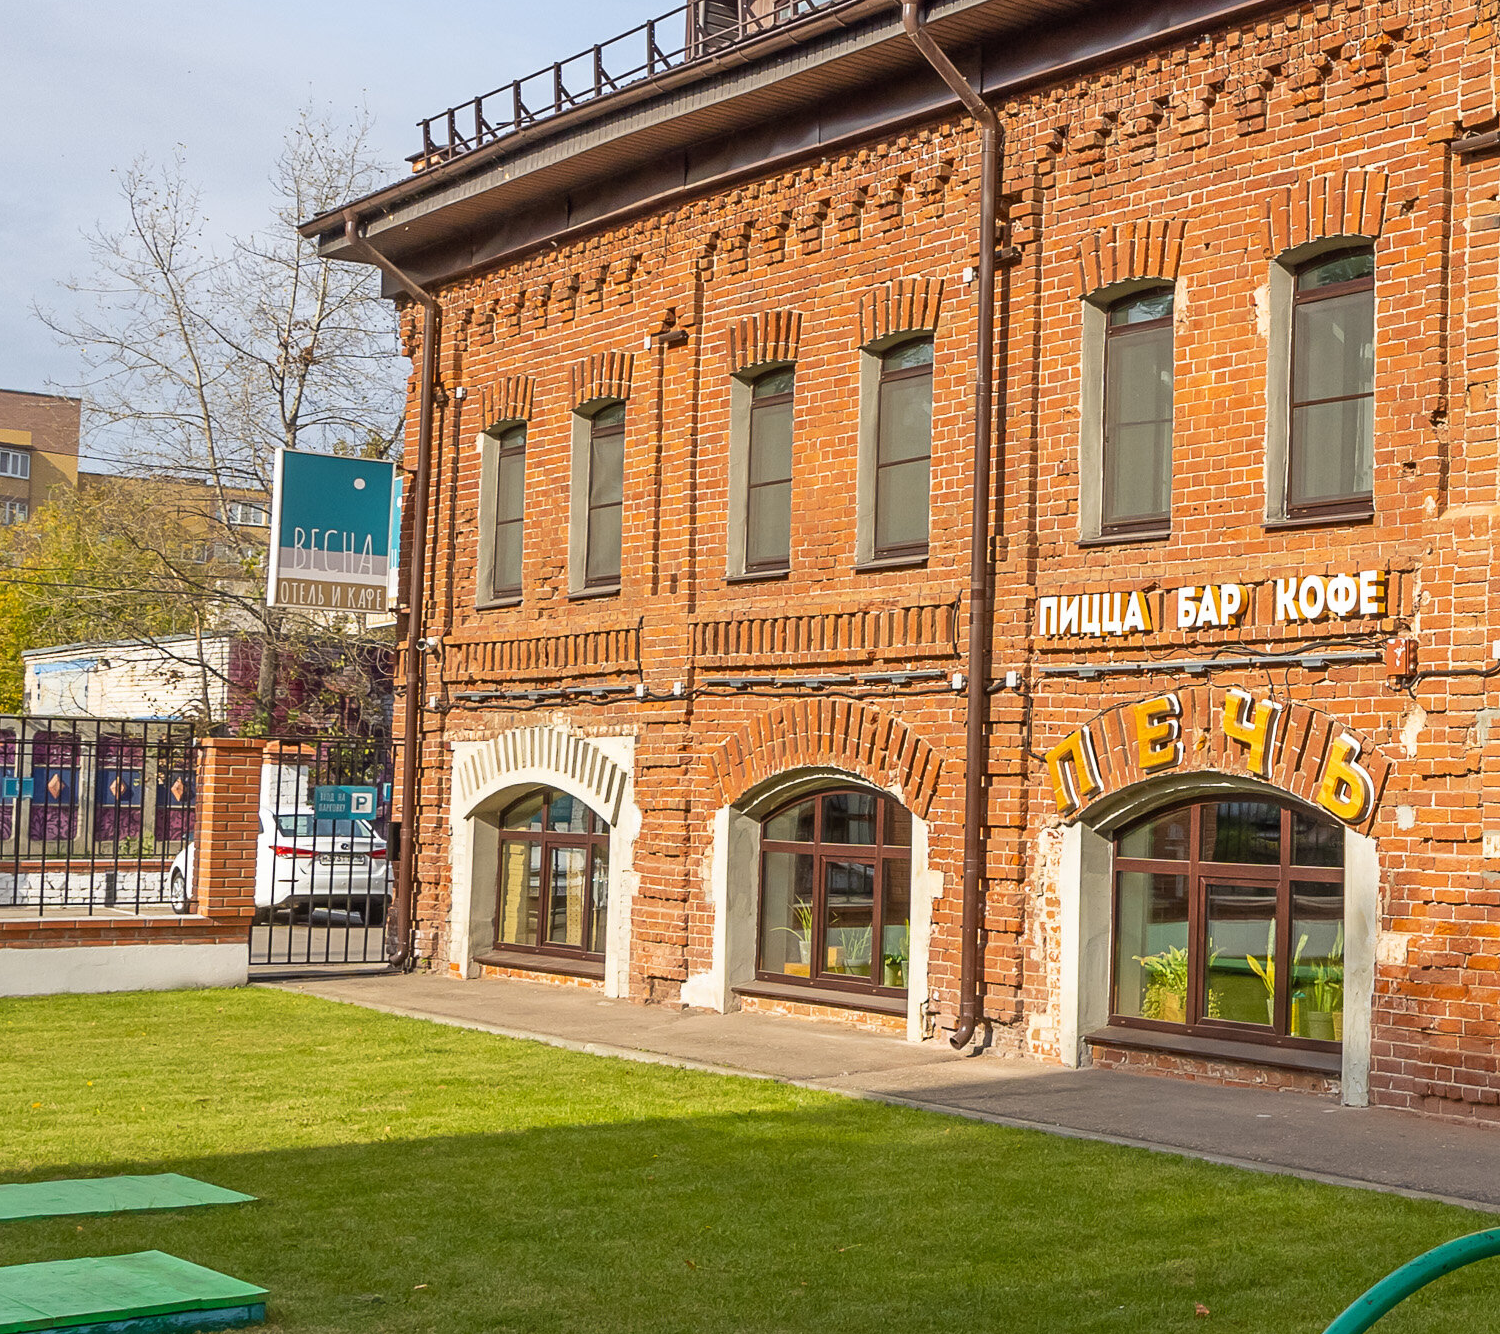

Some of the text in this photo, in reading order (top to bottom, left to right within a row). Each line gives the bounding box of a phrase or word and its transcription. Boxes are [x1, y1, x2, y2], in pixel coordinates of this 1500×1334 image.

[293, 527, 374, 575] ВЕСНА
[280, 581, 382, 610] ОТЕЛЬ И КАФЕ
[1038, 569, 1389, 637] ПИЦЦА БАР КОФЕ
[1046, 688, 1375, 824] ПЕЧЬ
